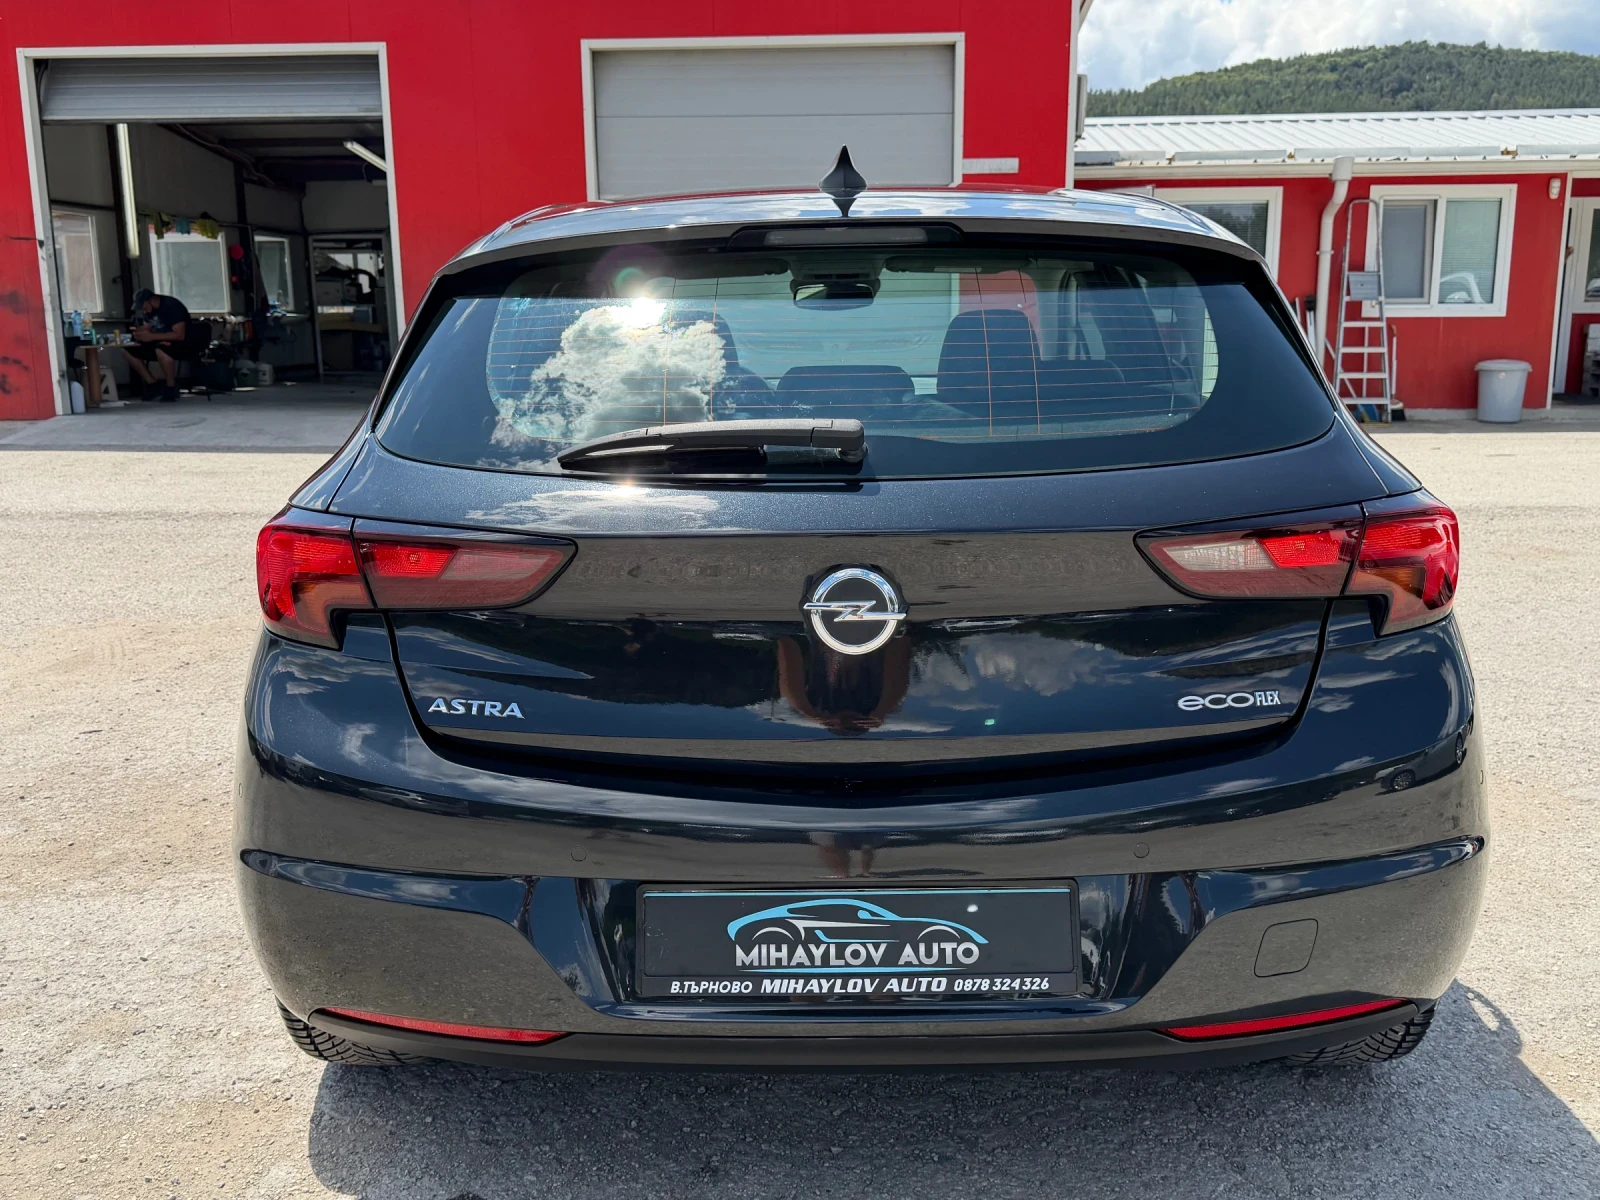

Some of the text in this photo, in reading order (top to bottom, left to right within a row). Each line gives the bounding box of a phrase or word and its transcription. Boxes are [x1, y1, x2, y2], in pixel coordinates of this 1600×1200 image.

[428, 698, 526, 719] ASTRA
[735, 942, 980, 967] MIHAYLOV AUTO
[670, 981, 753, 994] В.ТЪРНОВО
[760, 978, 880, 994] MIHAYLOV
[883, 977, 947, 992] AUTO
[953, 978, 990, 991] 0878
